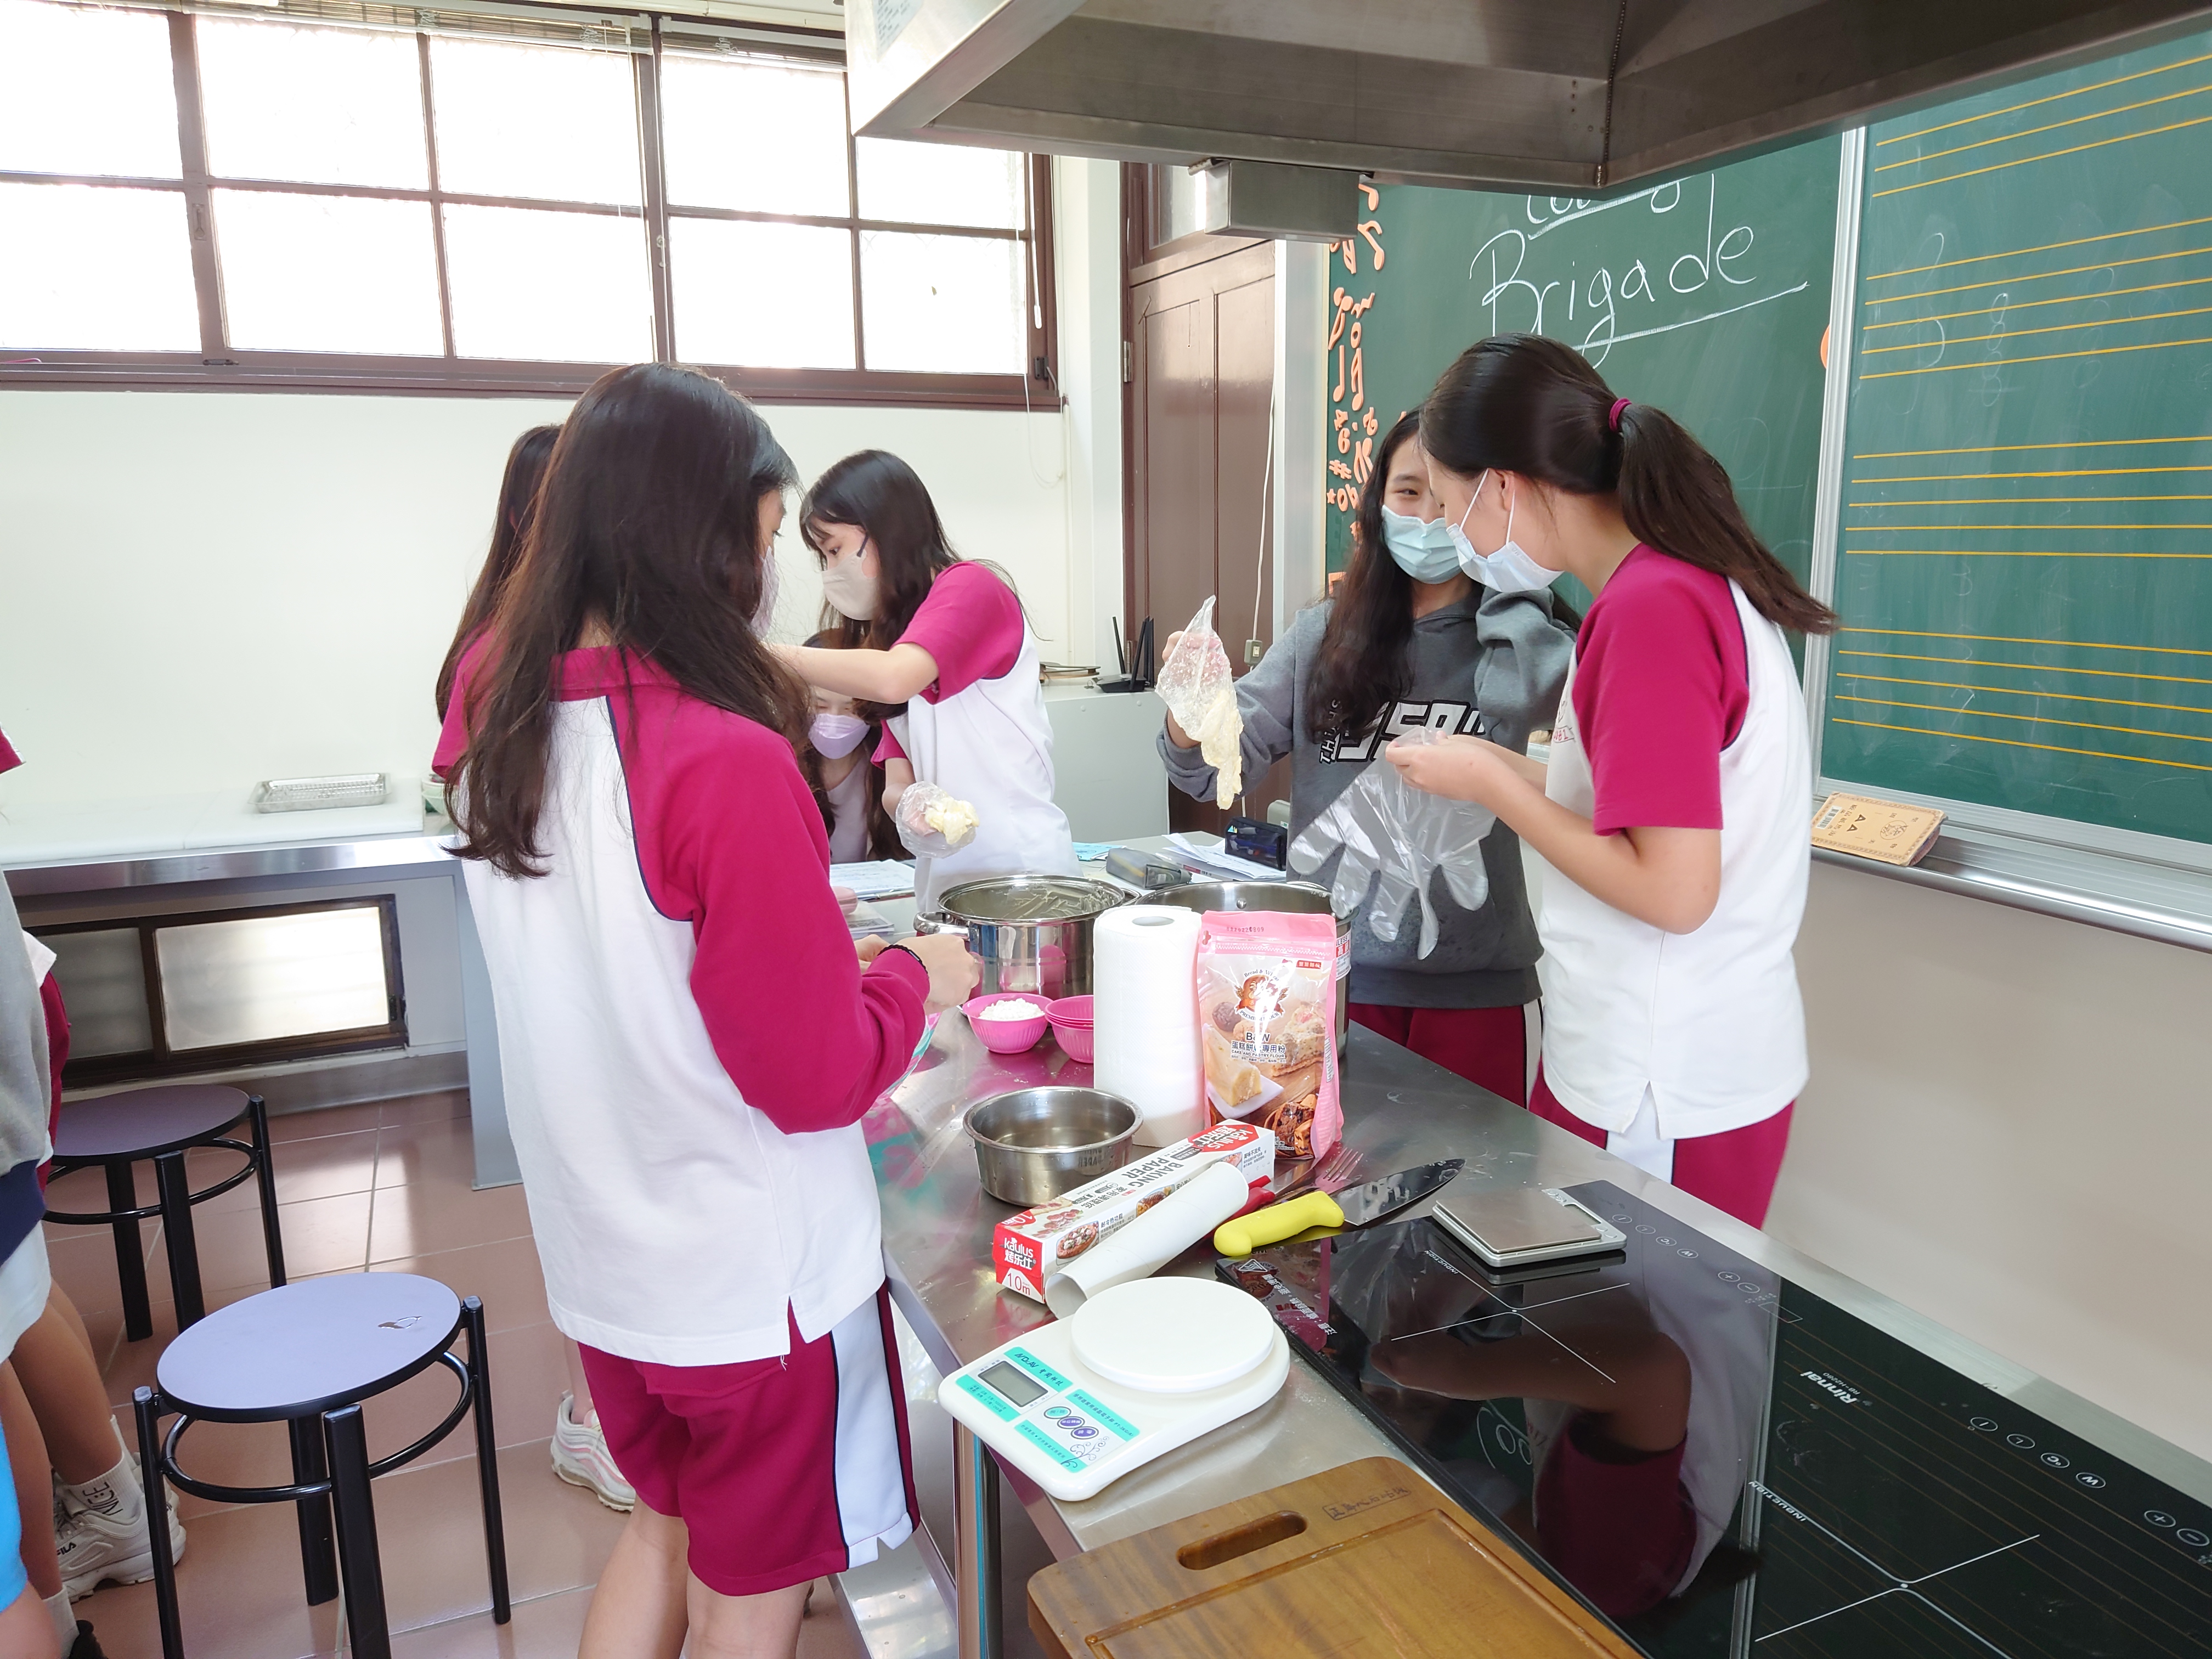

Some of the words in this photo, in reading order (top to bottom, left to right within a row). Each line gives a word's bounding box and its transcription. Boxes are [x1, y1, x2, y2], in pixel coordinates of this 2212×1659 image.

[1469, 173, 1757, 369] Brigade
[1207, 1128, 1253, 1149] kaulus
[1121, 1157, 1170, 1178] PAPER
[1127, 1162, 1184, 1188] BAKING
[1004, 1237, 1034, 1258] kaulus
[1424, 1250, 1458, 1274] INDUCTION
[1007, 1273, 1030, 1295] 10m
[1801, 1371, 1858, 1404] Rinnai
[1748, 1481, 1806, 1523] INDUCTION
